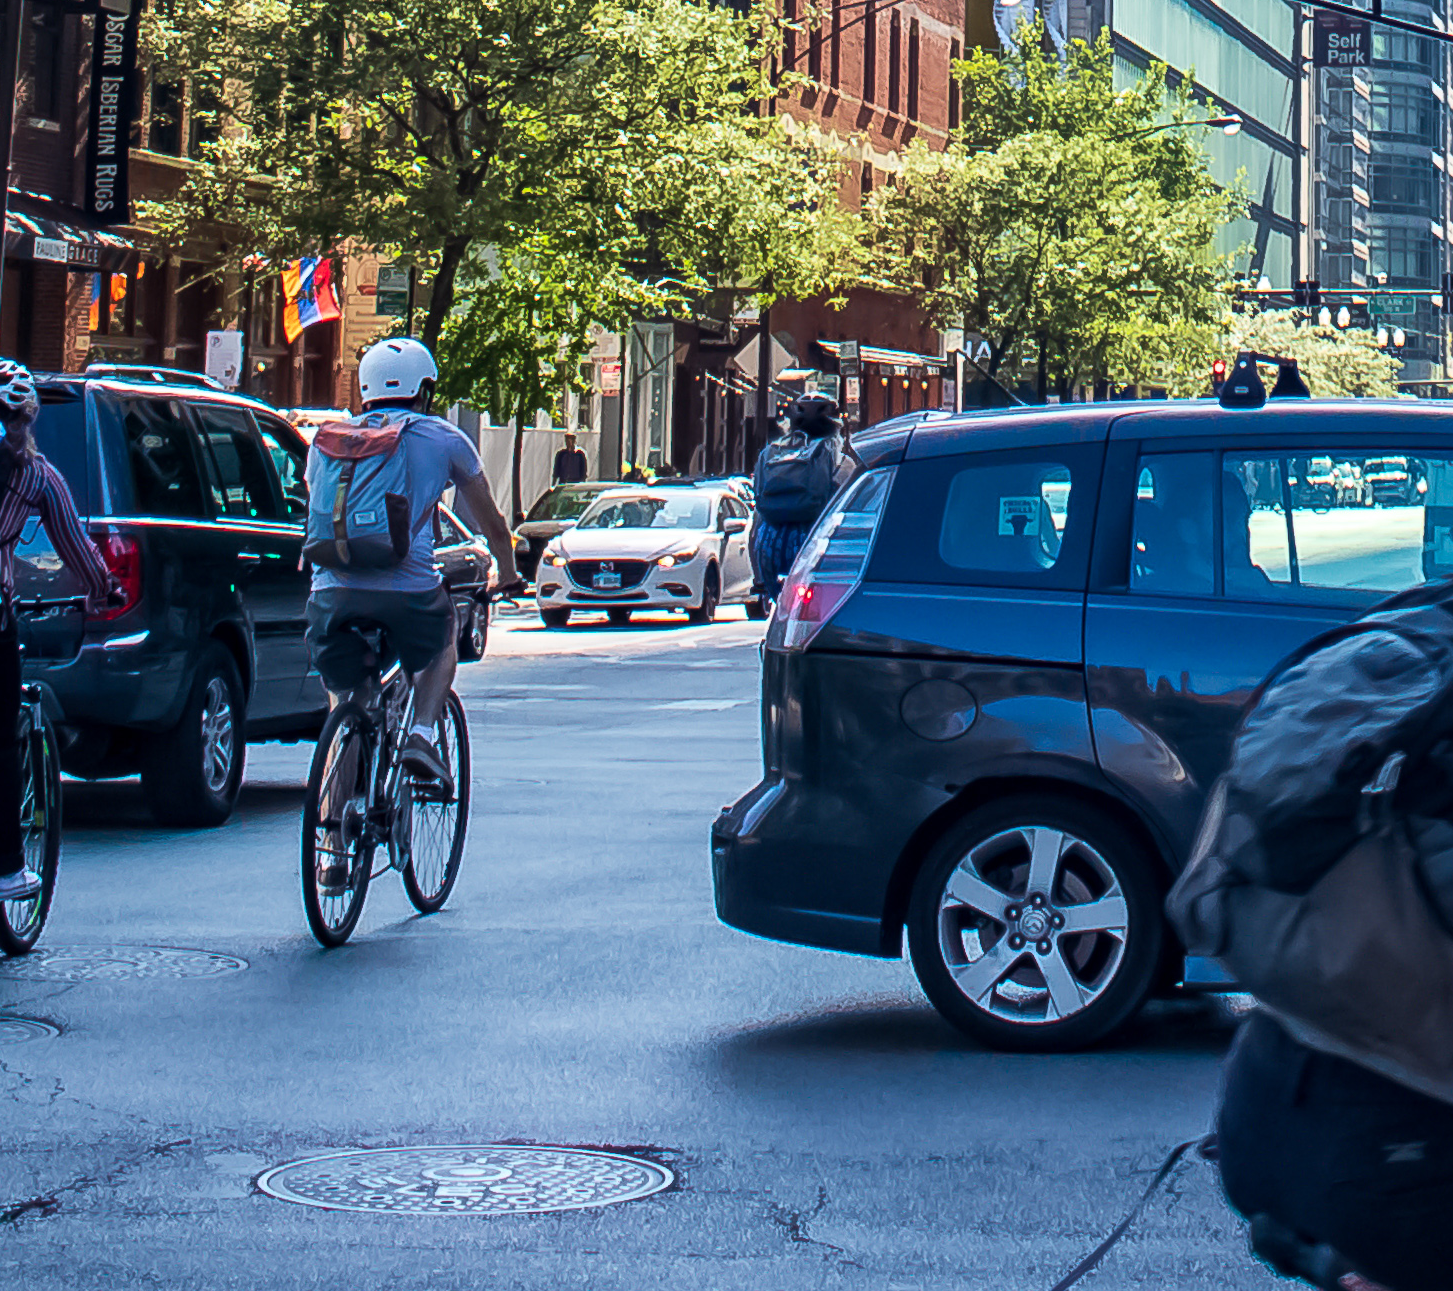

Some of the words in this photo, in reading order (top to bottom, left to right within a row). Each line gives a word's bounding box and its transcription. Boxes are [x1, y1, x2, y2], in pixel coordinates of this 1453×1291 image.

[1327, 49, 1365, 64] Park
[1328, 33, 1362, 48] Self
[97, 75, 124, 156] ISBERIAN
[94, 163, 118, 213] RUGS
